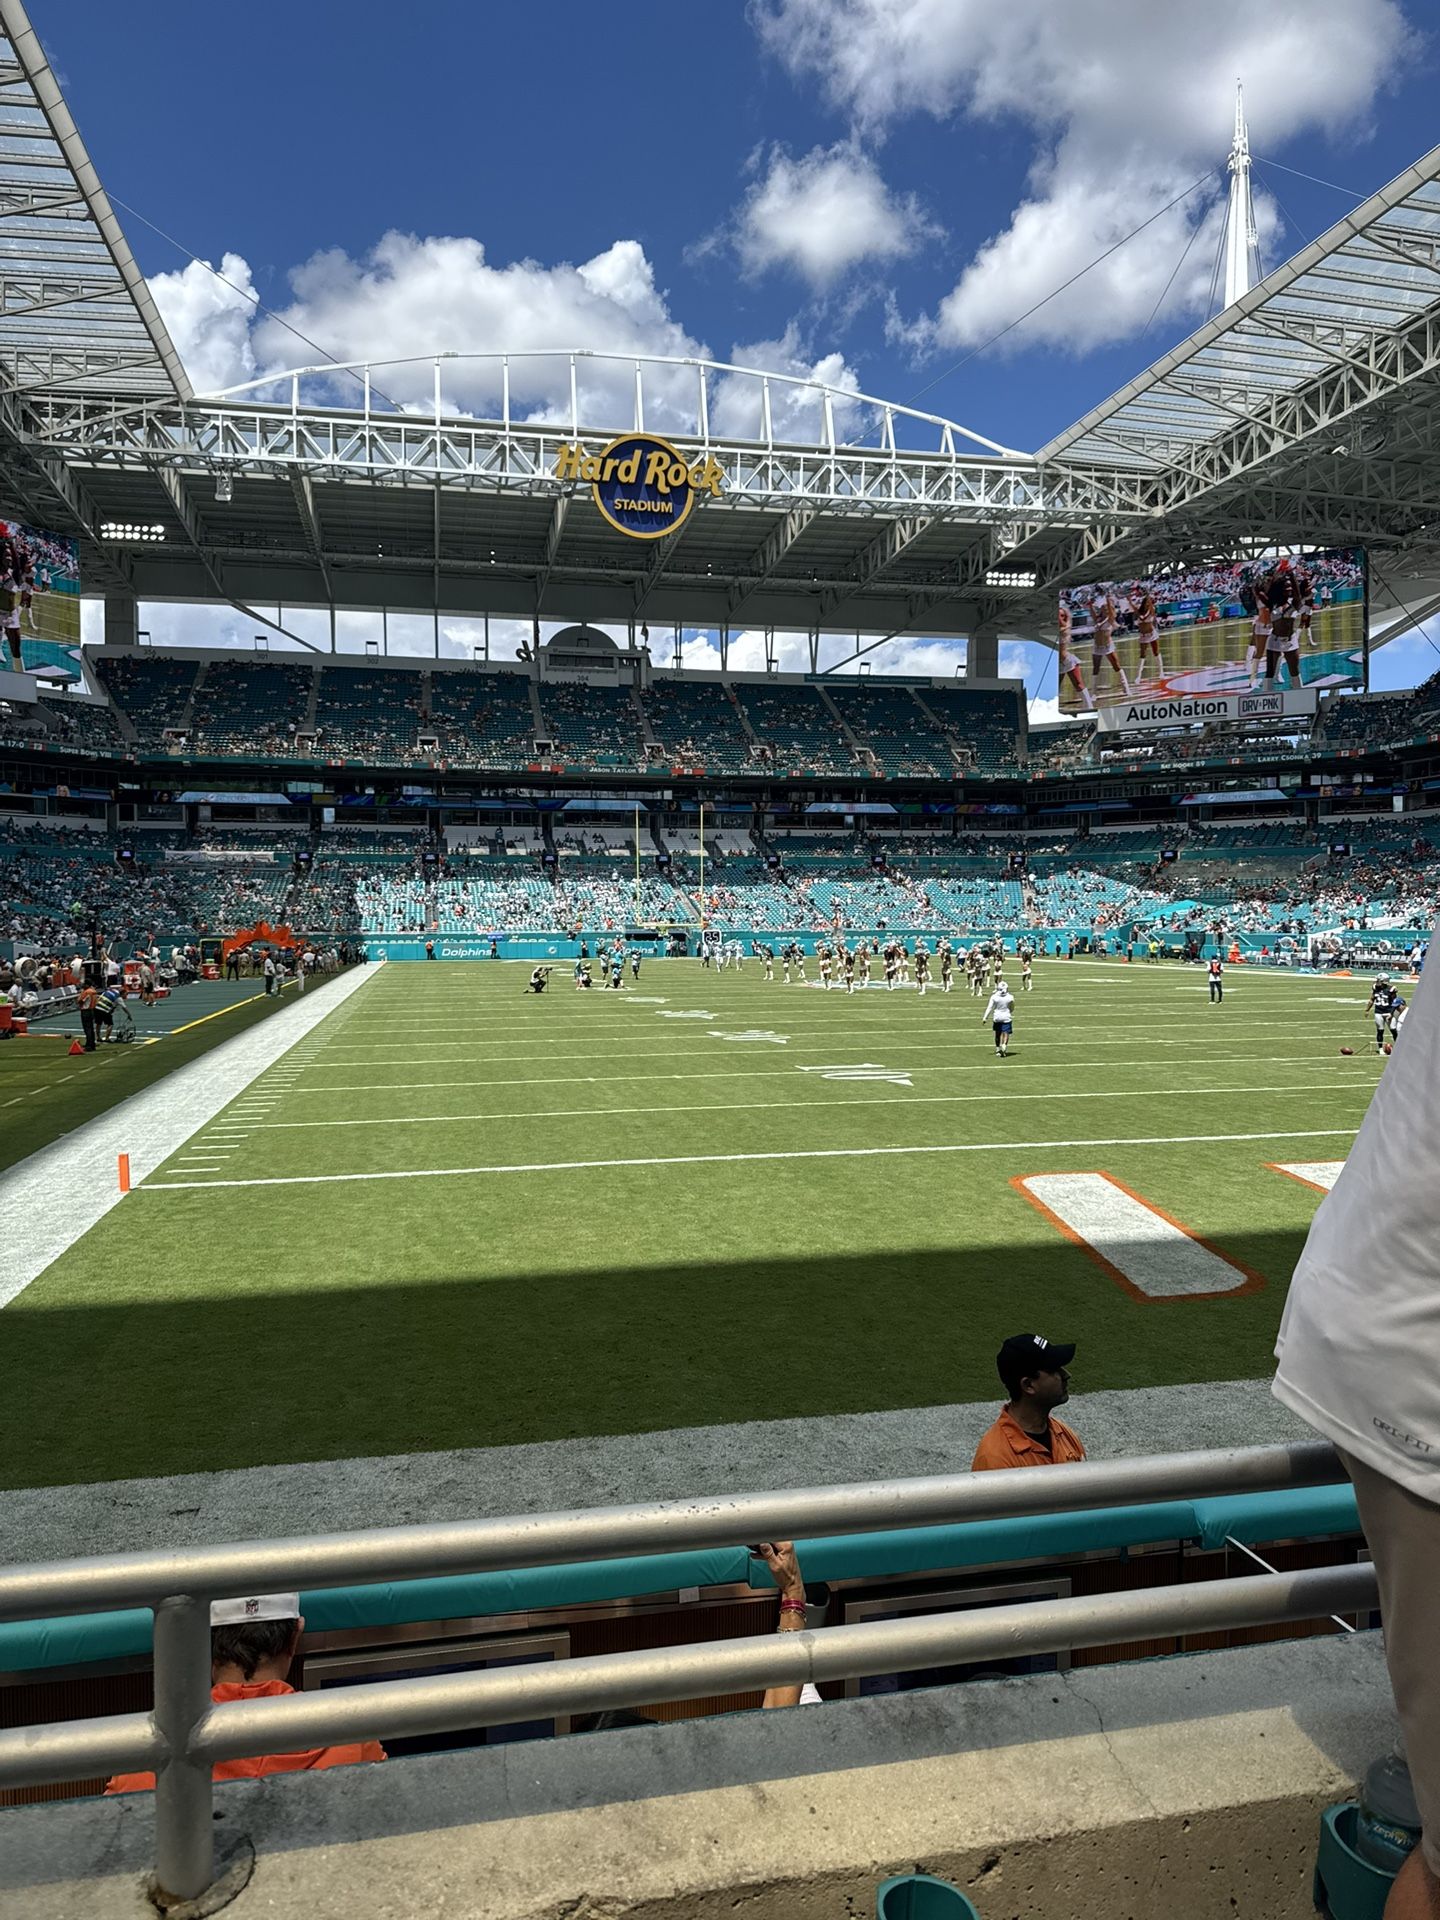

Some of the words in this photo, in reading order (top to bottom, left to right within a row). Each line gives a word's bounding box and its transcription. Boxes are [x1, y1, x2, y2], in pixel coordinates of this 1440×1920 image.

[555, 444, 642, 484] Hard
[645, 450, 726, 497] Rock
[614, 498, 673, 514] STADIUM
[1126, 700, 1228, 722] AutoNation
[1280, 754, 1310, 762] CSONKA
[1312, 752, 1322, 760] 39
[441, 948, 492, 957] Dolphins
